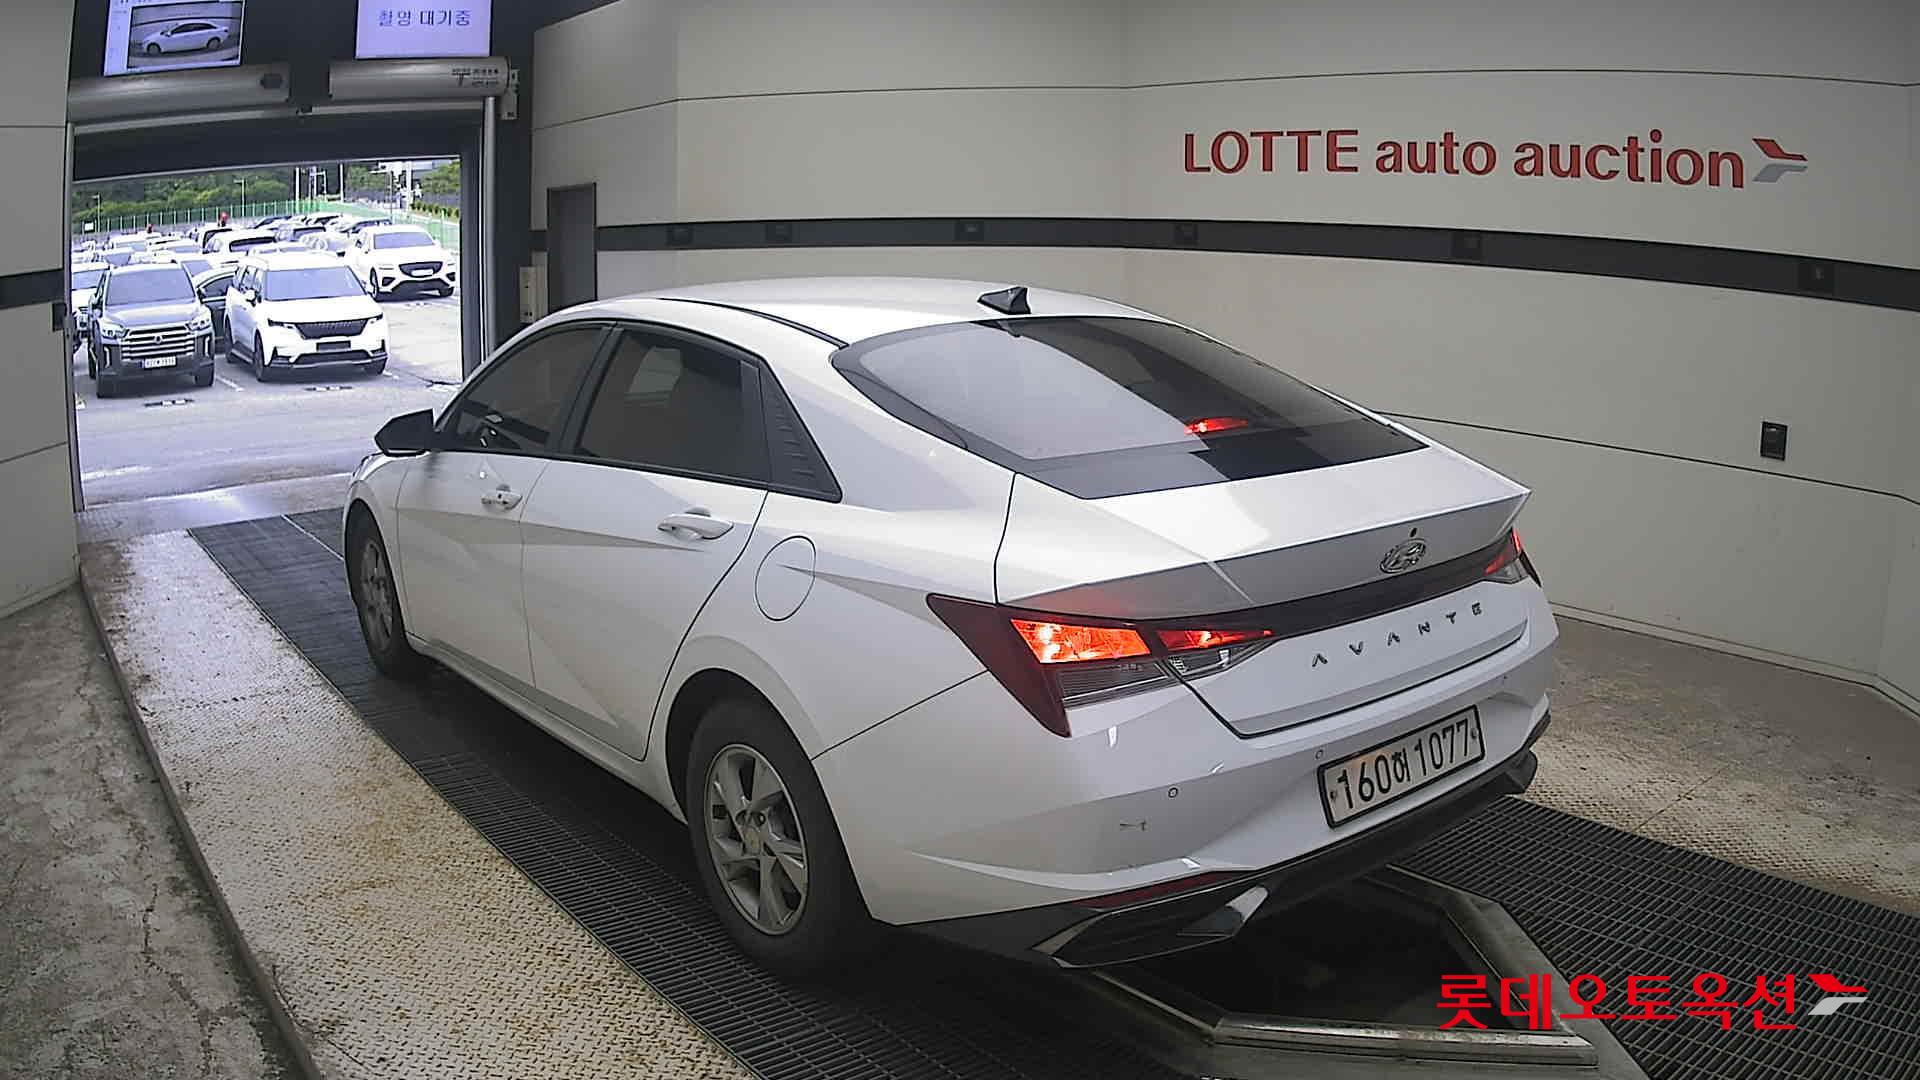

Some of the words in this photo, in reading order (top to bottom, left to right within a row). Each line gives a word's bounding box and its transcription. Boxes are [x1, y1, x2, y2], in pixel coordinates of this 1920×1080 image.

[419, 9, 471, 27] 대기중
[1184, 128, 1360, 175] LOTTE
[1376, 130, 1498, 177] auto
[1513, 129, 1745, 189] auction
[1311, 602, 1482, 668] AVANTE
[1413, 717, 1469, 777] 1077
